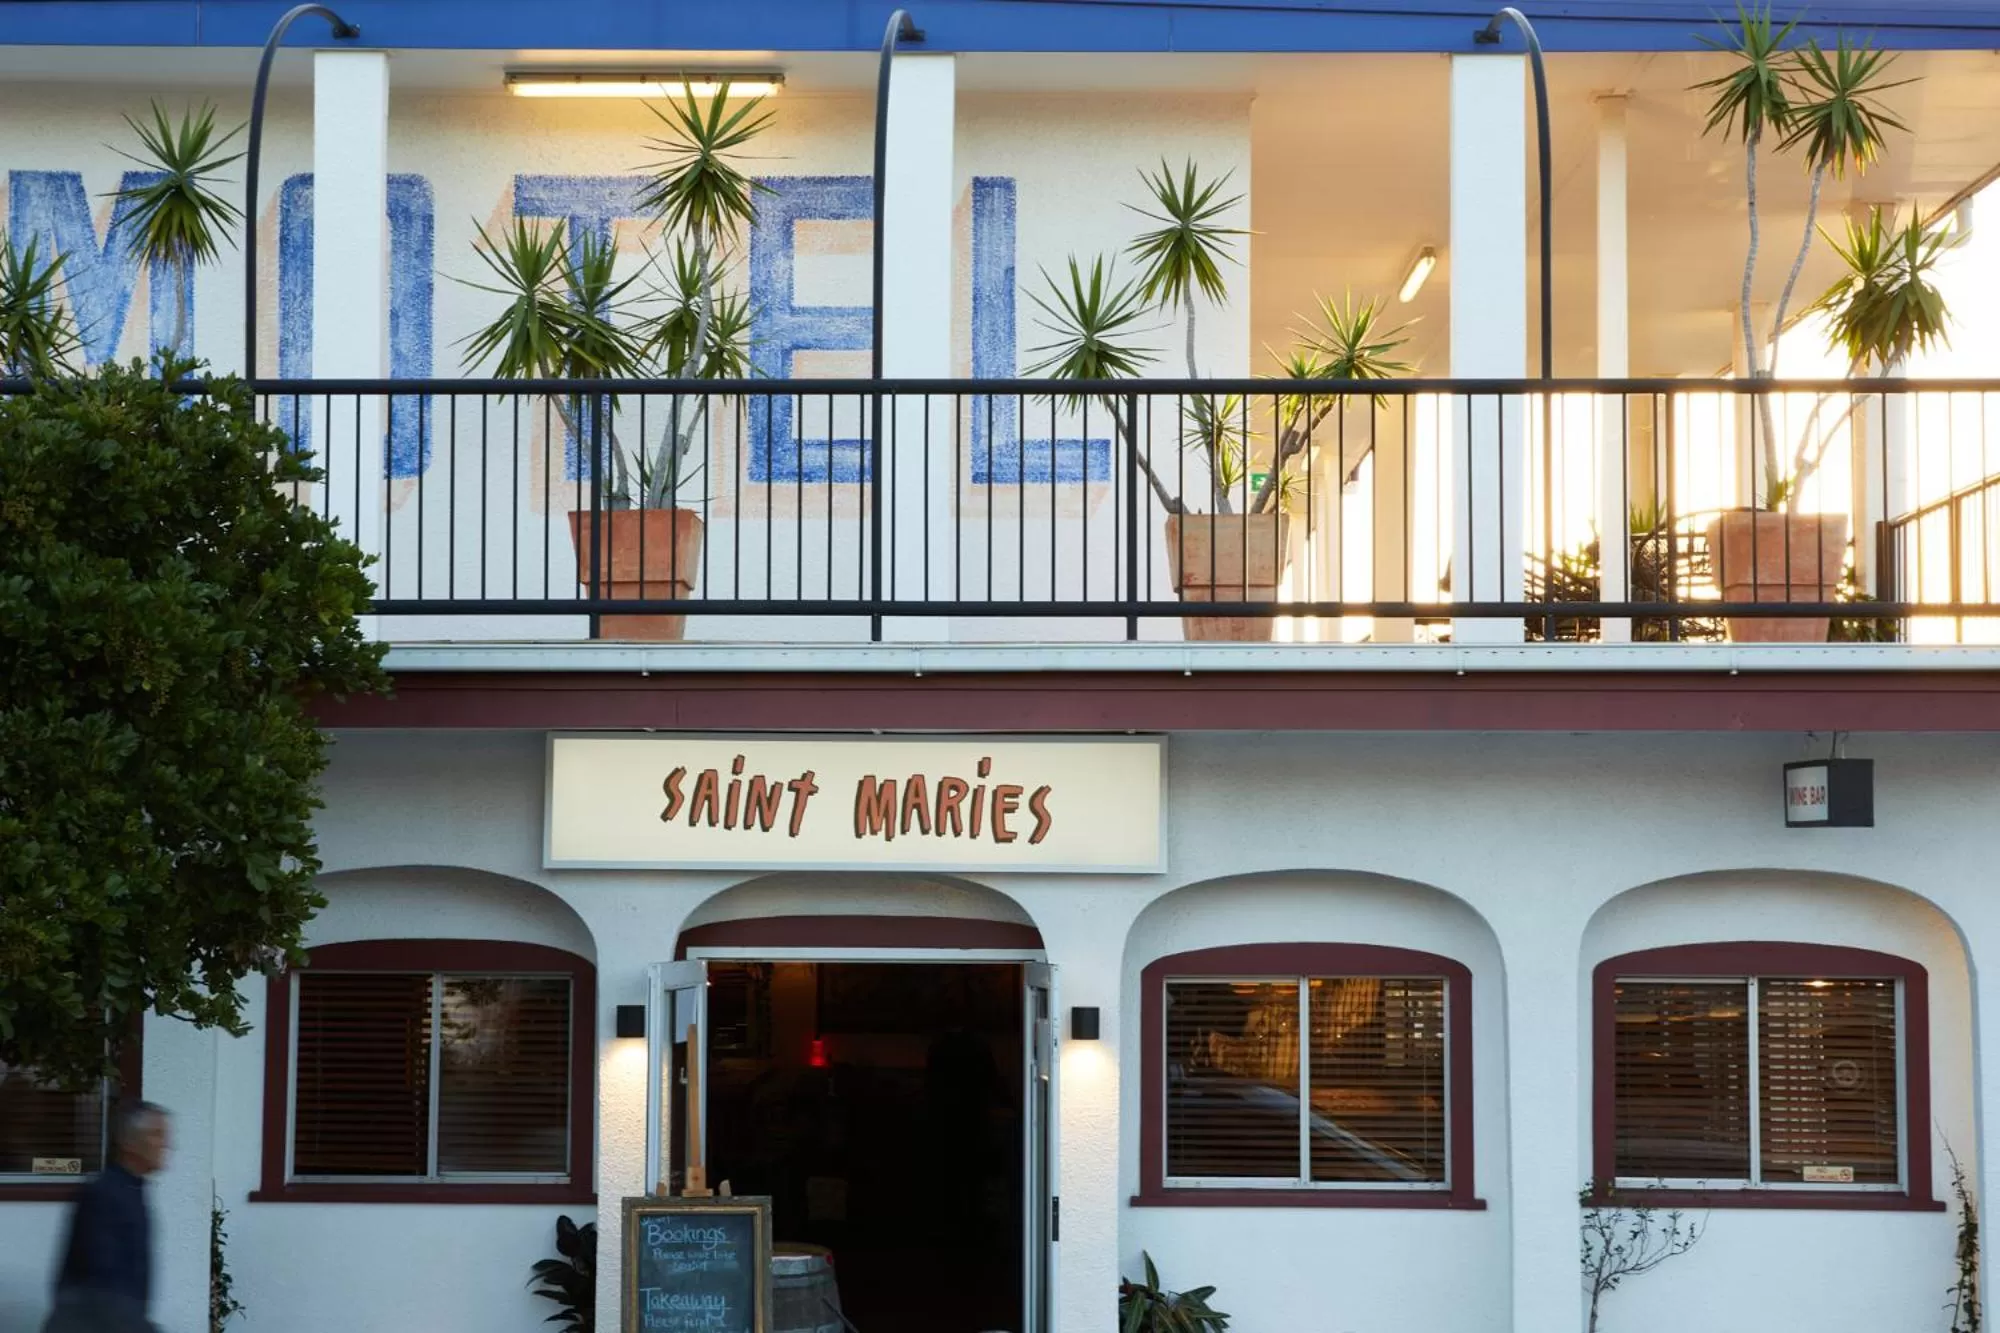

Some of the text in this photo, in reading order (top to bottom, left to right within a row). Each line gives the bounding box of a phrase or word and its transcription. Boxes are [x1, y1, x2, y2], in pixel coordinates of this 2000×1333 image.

[1810, 785, 1826, 805] BAR
[647, 1224, 727, 1251] Bookings
[640, 1287, 725, 1319] Takeaway
